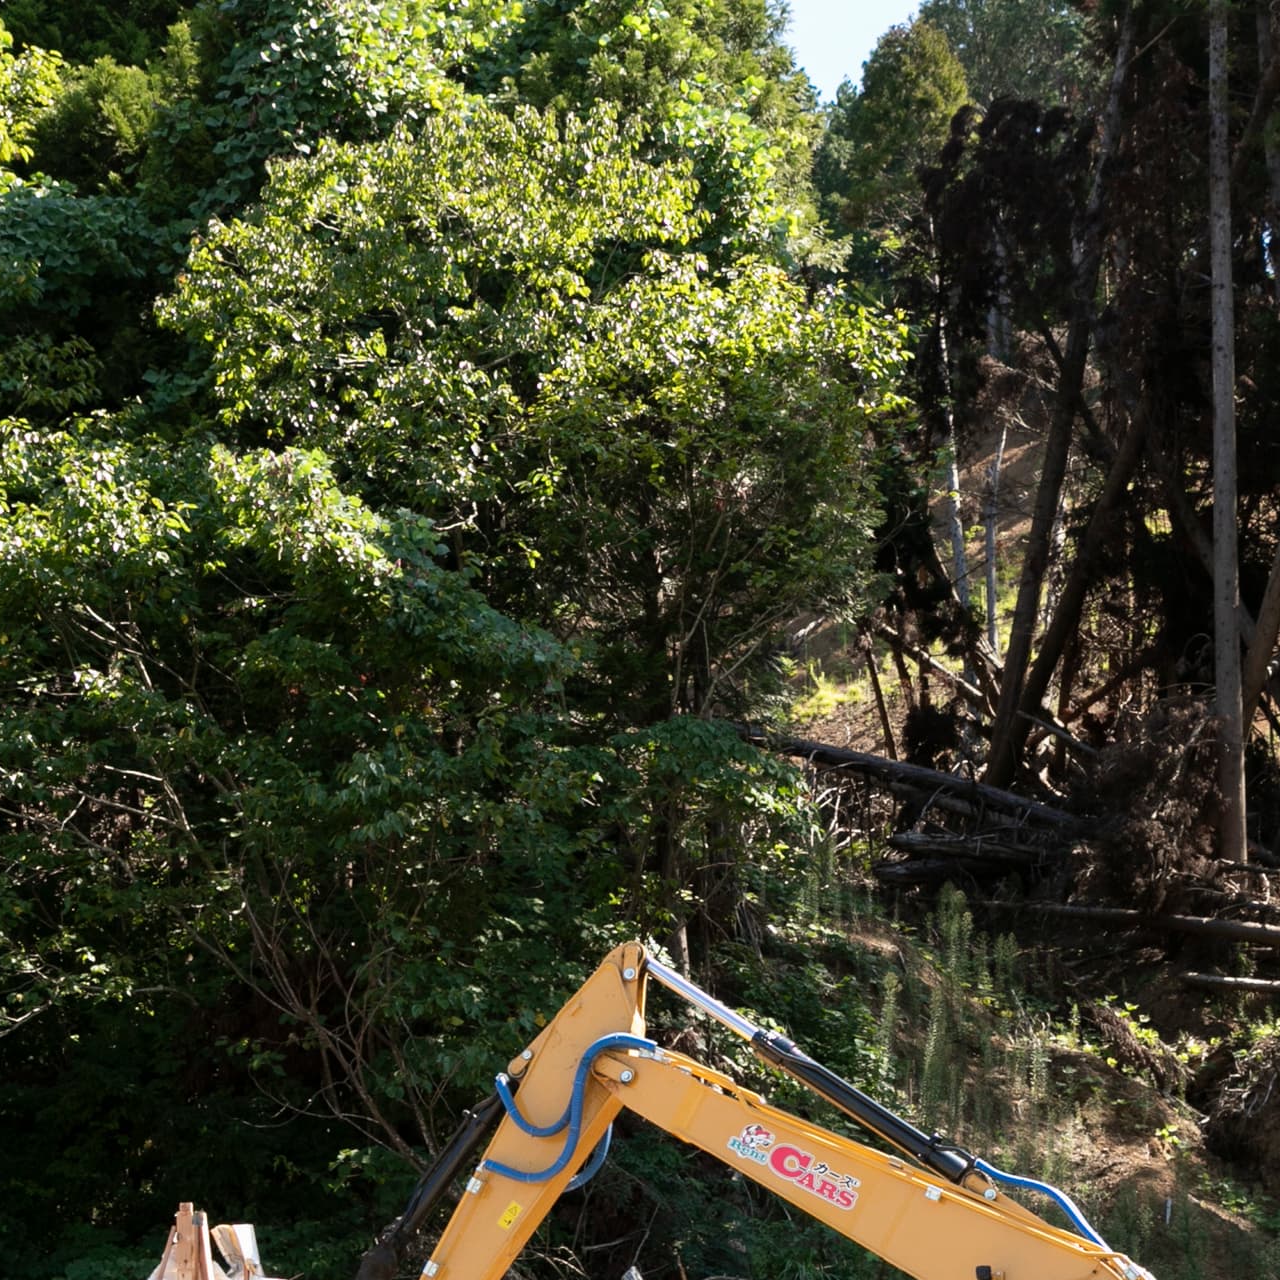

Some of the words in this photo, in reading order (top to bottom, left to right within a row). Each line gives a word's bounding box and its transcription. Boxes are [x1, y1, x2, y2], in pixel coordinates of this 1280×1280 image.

[730, 1138, 767, 1163] Rent
[770, 1146, 855, 1208] CARS
[814, 1163, 859, 1188] カーズ
